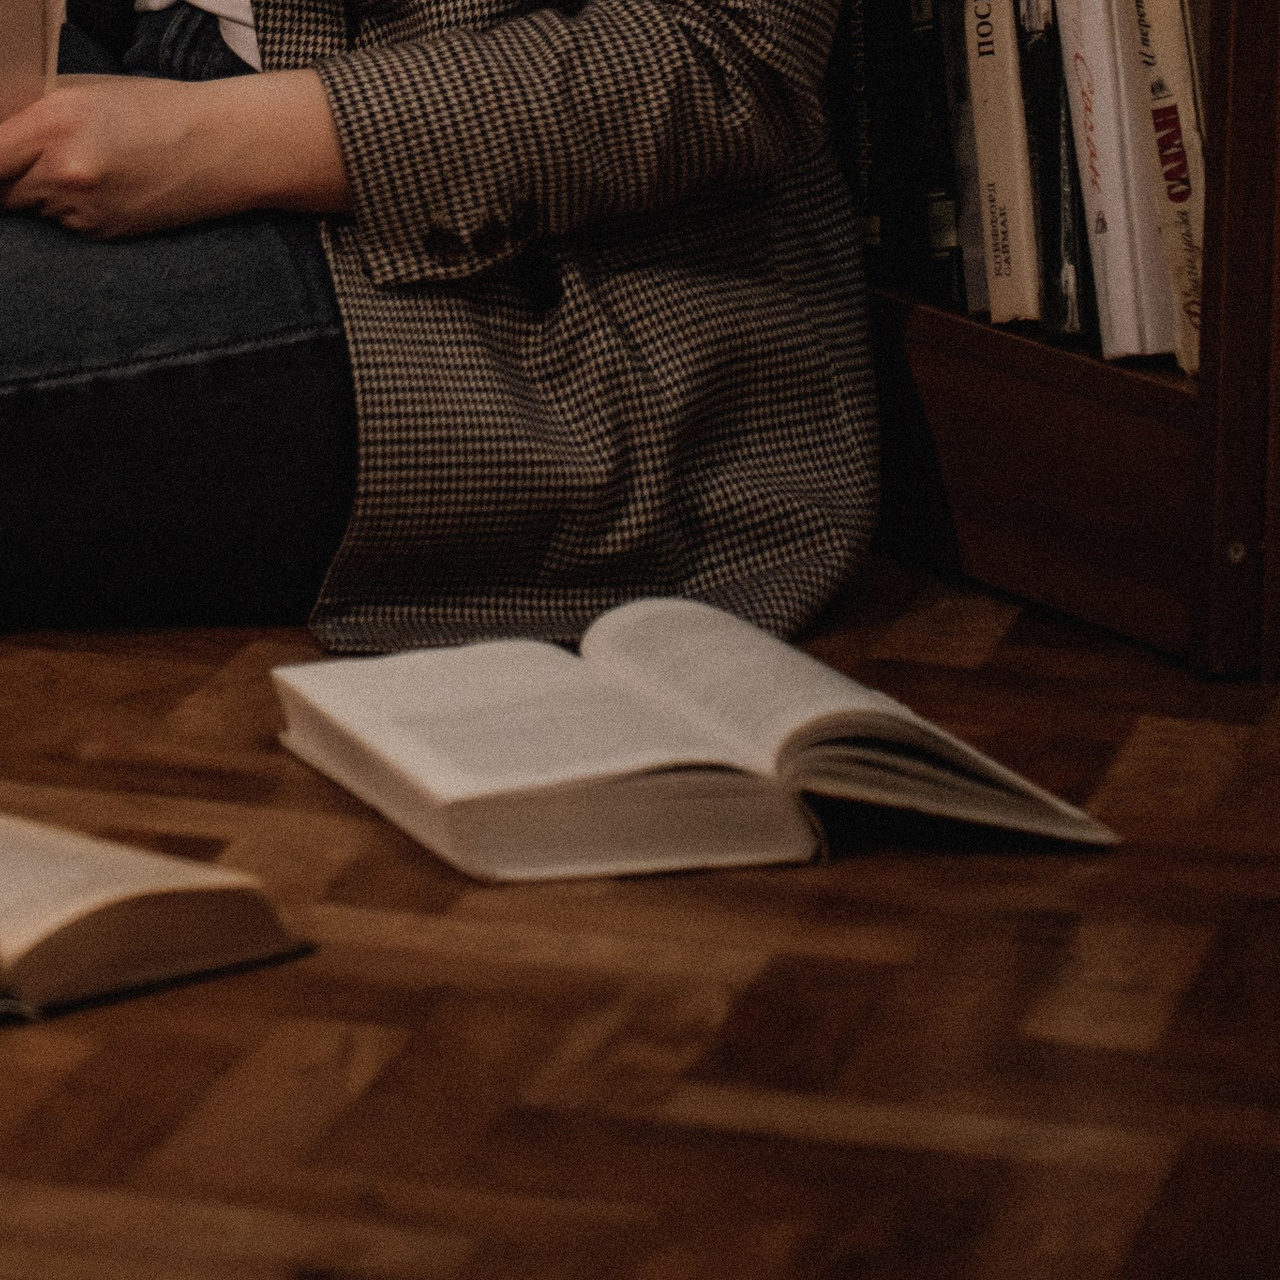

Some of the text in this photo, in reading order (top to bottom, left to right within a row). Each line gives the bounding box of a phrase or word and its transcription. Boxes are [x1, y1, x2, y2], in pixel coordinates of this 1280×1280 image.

[1151, 102, 1192, 204] САГАН
[987, 181, 1003, 278] КЛИФФОРД
[998, 205, 1013, 278] САЙМАК
